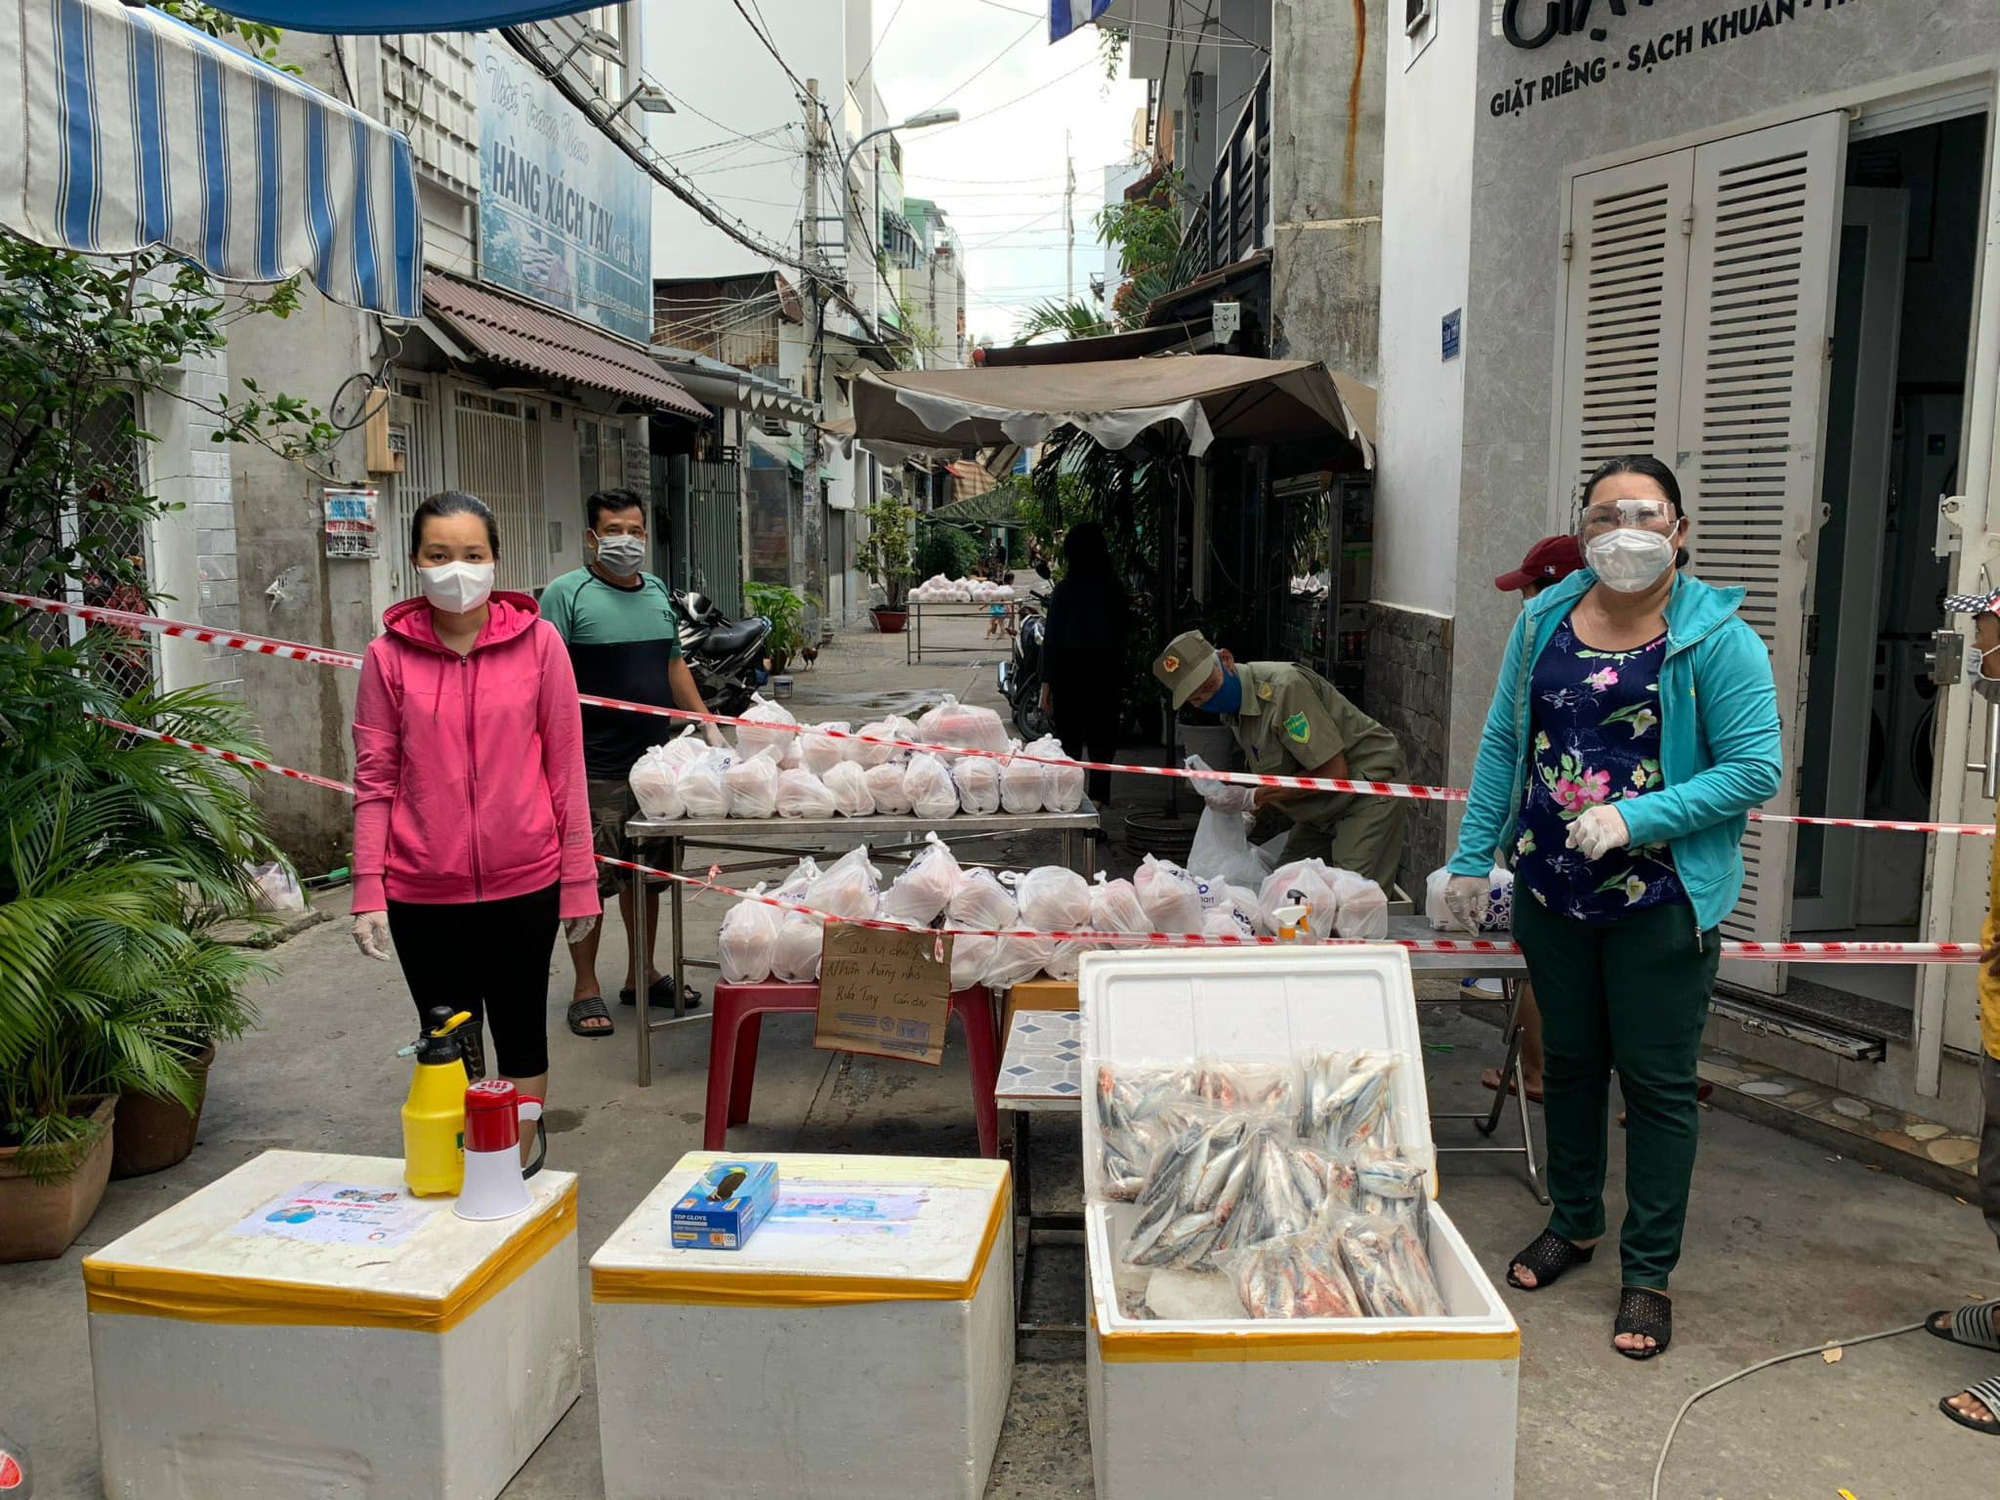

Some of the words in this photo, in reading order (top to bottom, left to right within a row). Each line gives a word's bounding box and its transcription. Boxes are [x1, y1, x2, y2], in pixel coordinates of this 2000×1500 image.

[1490, 78, 1536, 117] GIẶT
[1541, 60, 1606, 101] RIÊNG
[1627, 26, 1693, 74] SẠCH
[493, 136, 541, 216] HÀNG
[545, 170, 584, 240] XÁCH
[588, 201, 613, 254] TAY
[687, 1214, 708, 1222] GLOVE
